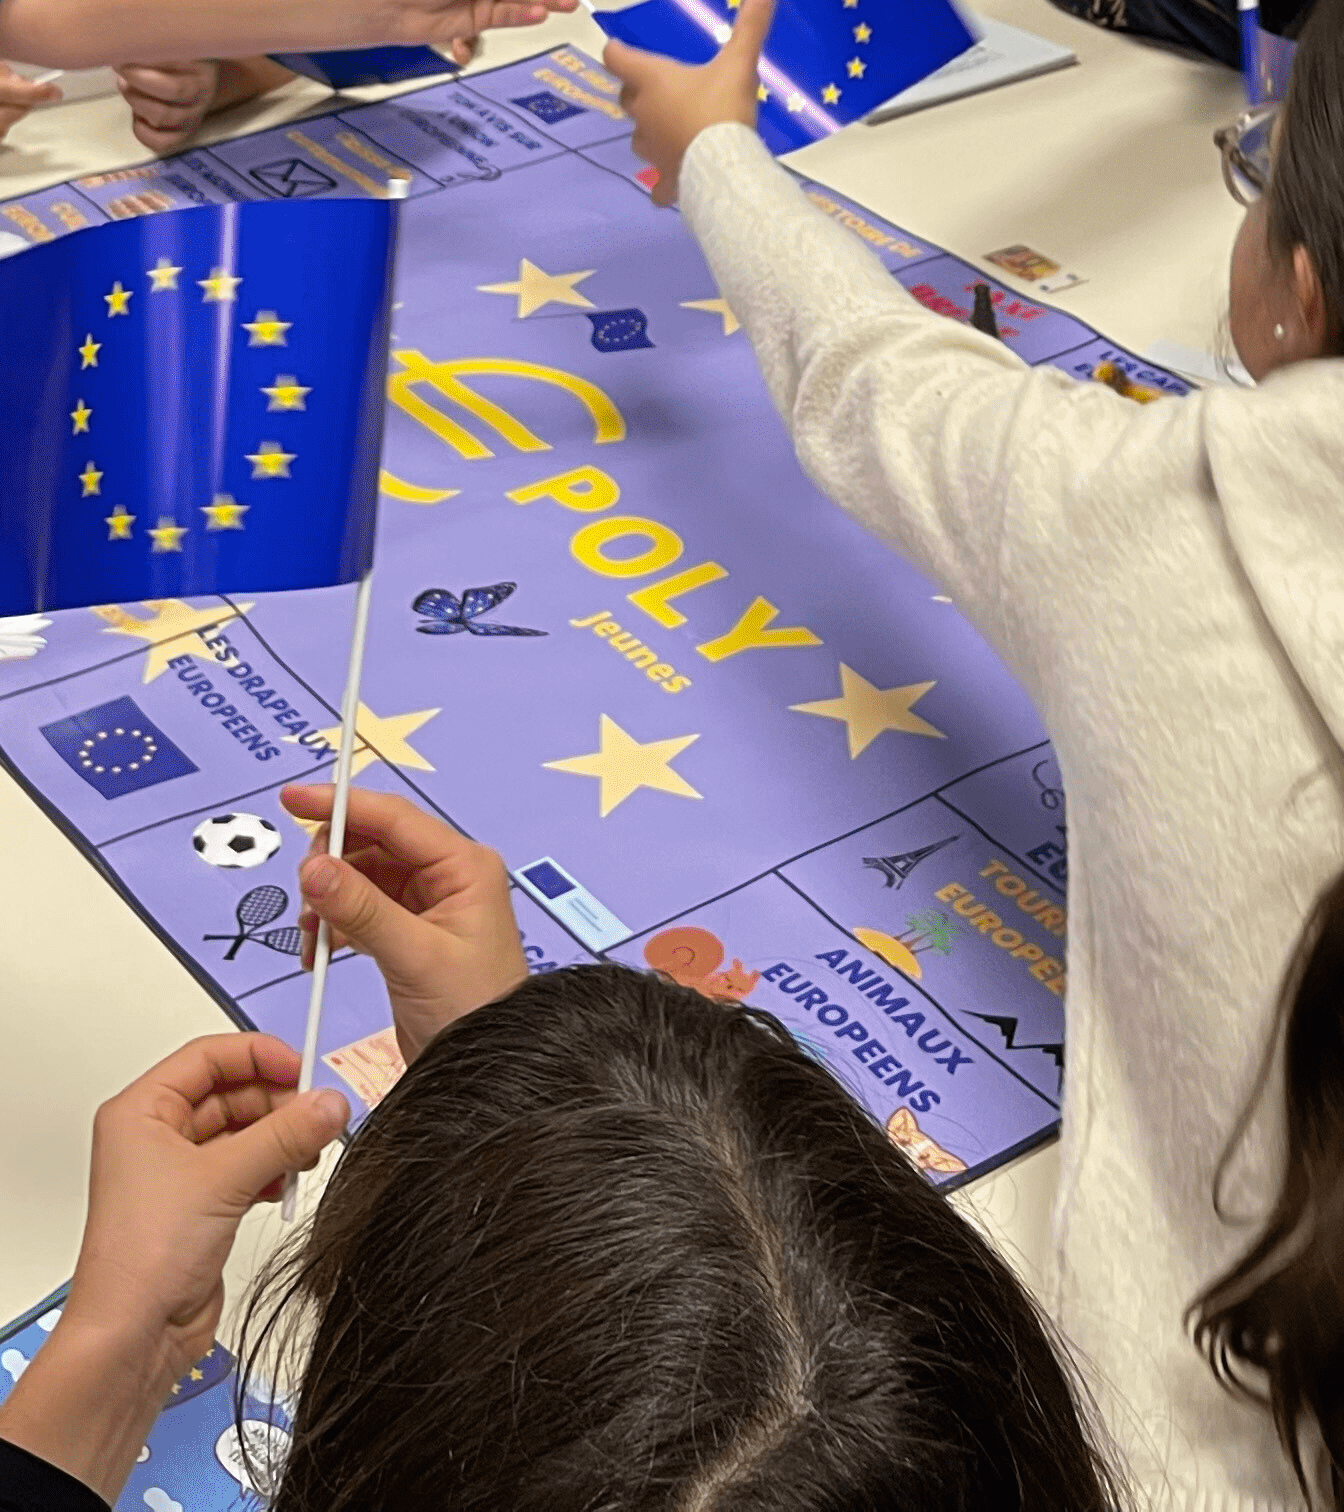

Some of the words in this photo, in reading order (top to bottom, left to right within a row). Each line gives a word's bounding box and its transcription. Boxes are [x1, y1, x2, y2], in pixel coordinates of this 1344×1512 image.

[167, 653, 282, 763] EUROPEENS
[194, 623, 238, 663] LES
[226, 658, 340, 762] DRAPEAUX
[758, 960, 941, 1113] EUROPEENS
[814, 946, 976, 1076] ANIMAUX
